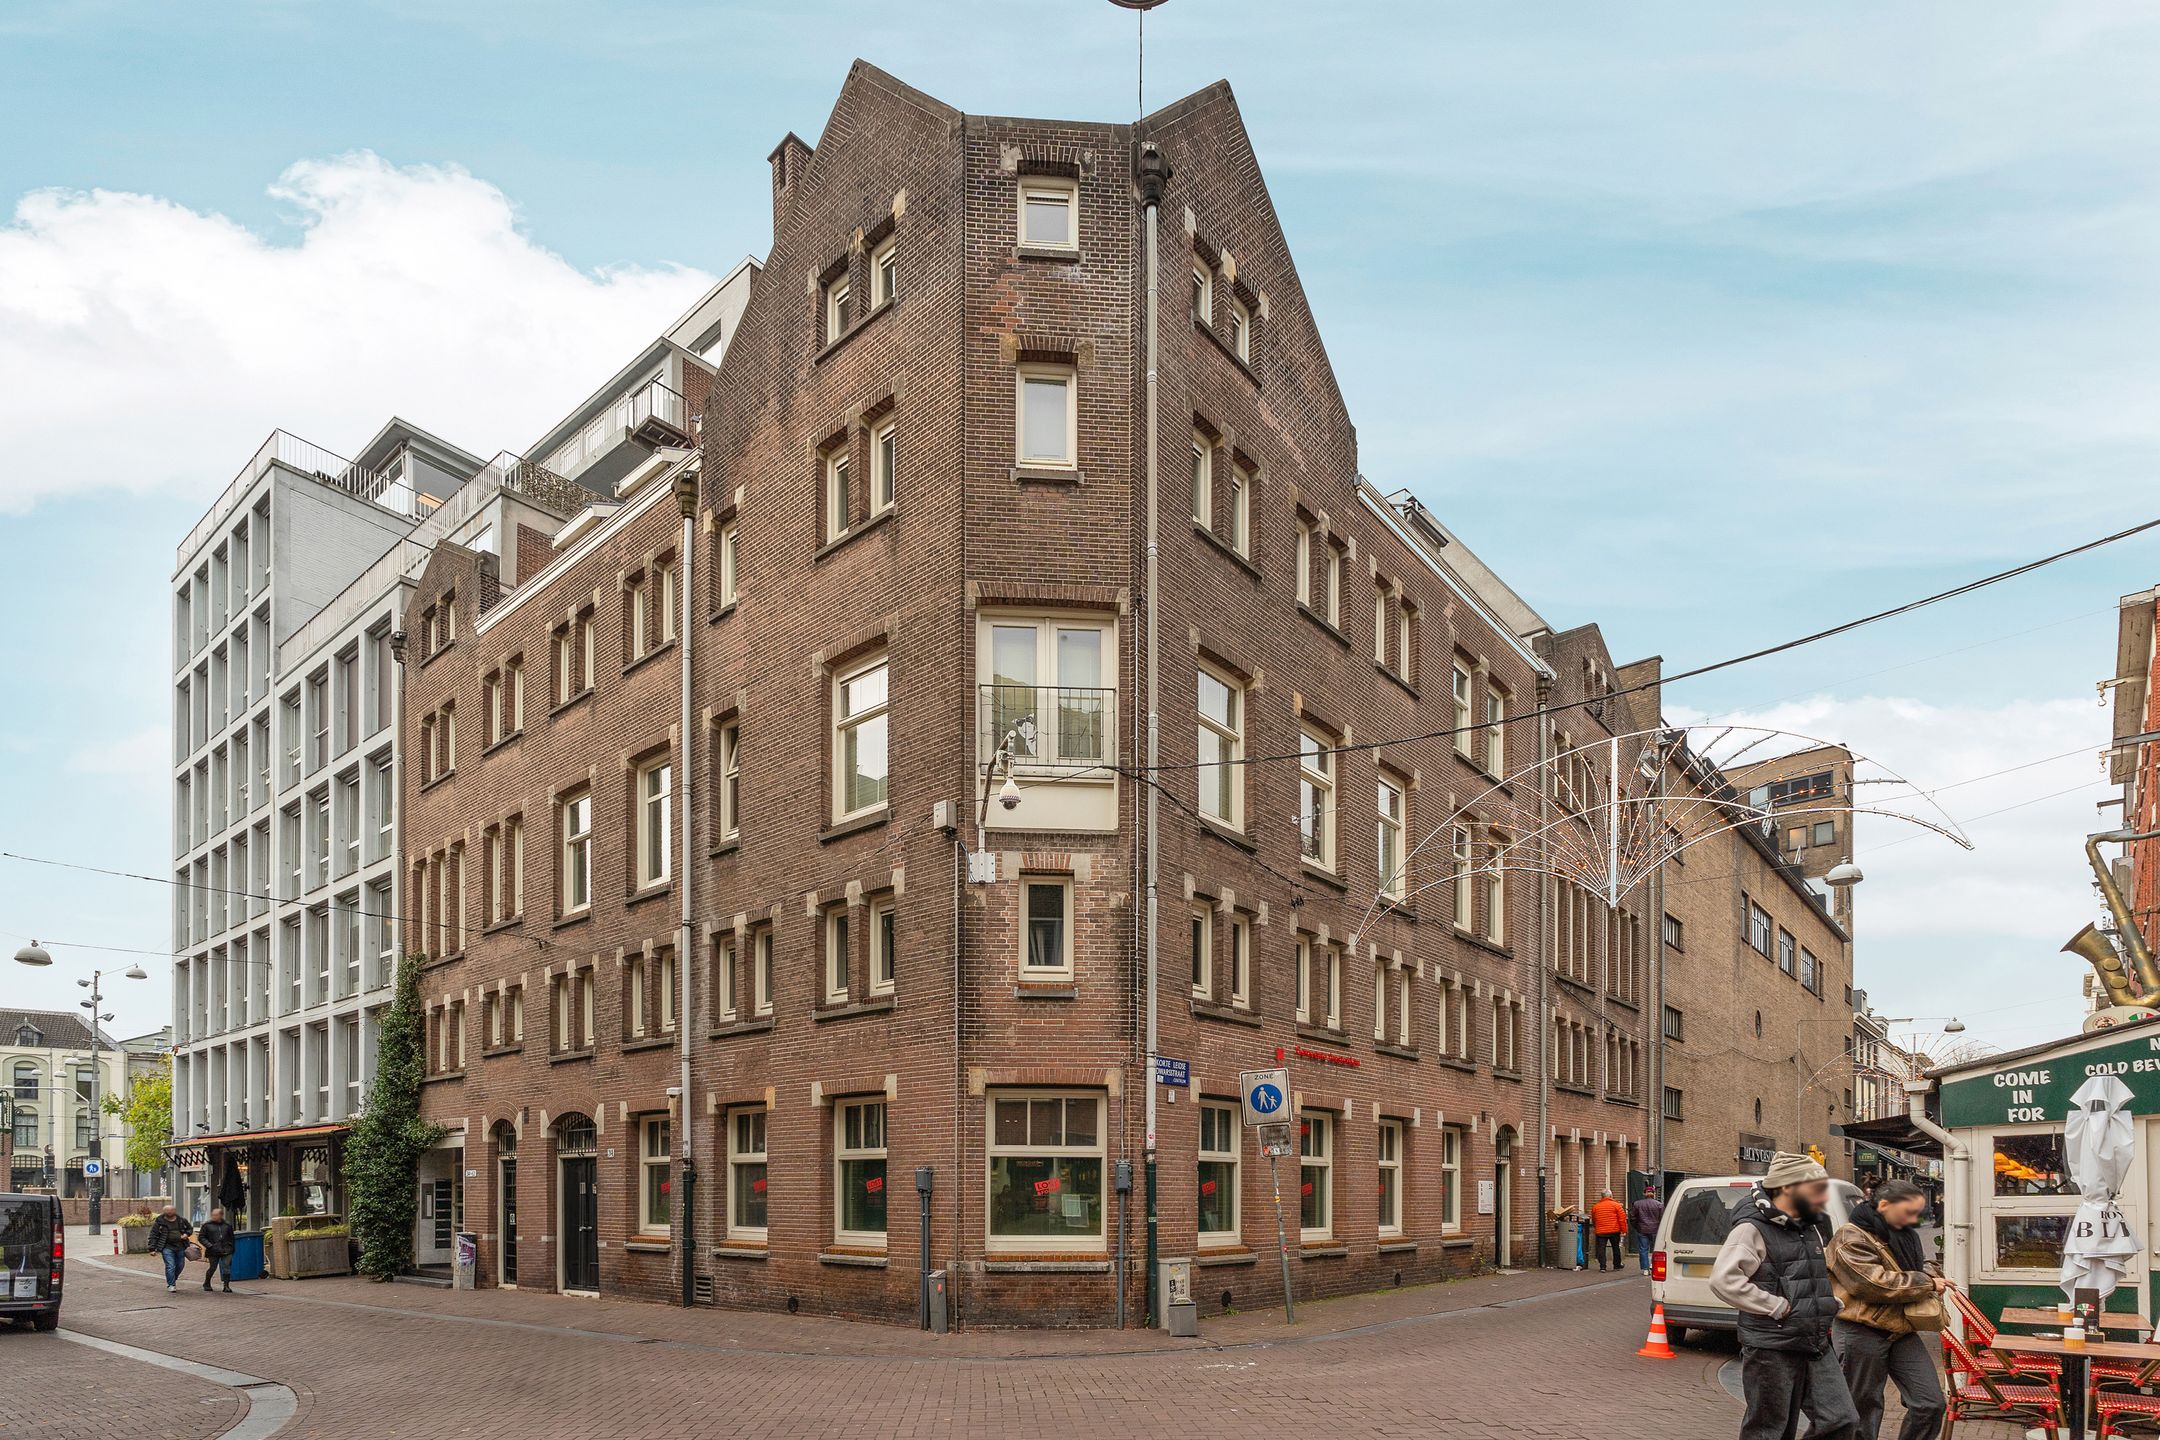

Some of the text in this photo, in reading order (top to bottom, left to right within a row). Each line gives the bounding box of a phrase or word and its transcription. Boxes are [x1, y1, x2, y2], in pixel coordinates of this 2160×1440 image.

[1172, 1061, 1187, 1070] LEIDSE
[2085, 1061, 2128, 1076] COLD
[1993, 1070, 2051, 1087] COME
[2012, 1090, 2033, 1104] IN
[2007, 1107, 2045, 1123] FOR
[1743, 1146, 1760, 1161] JACK'S
